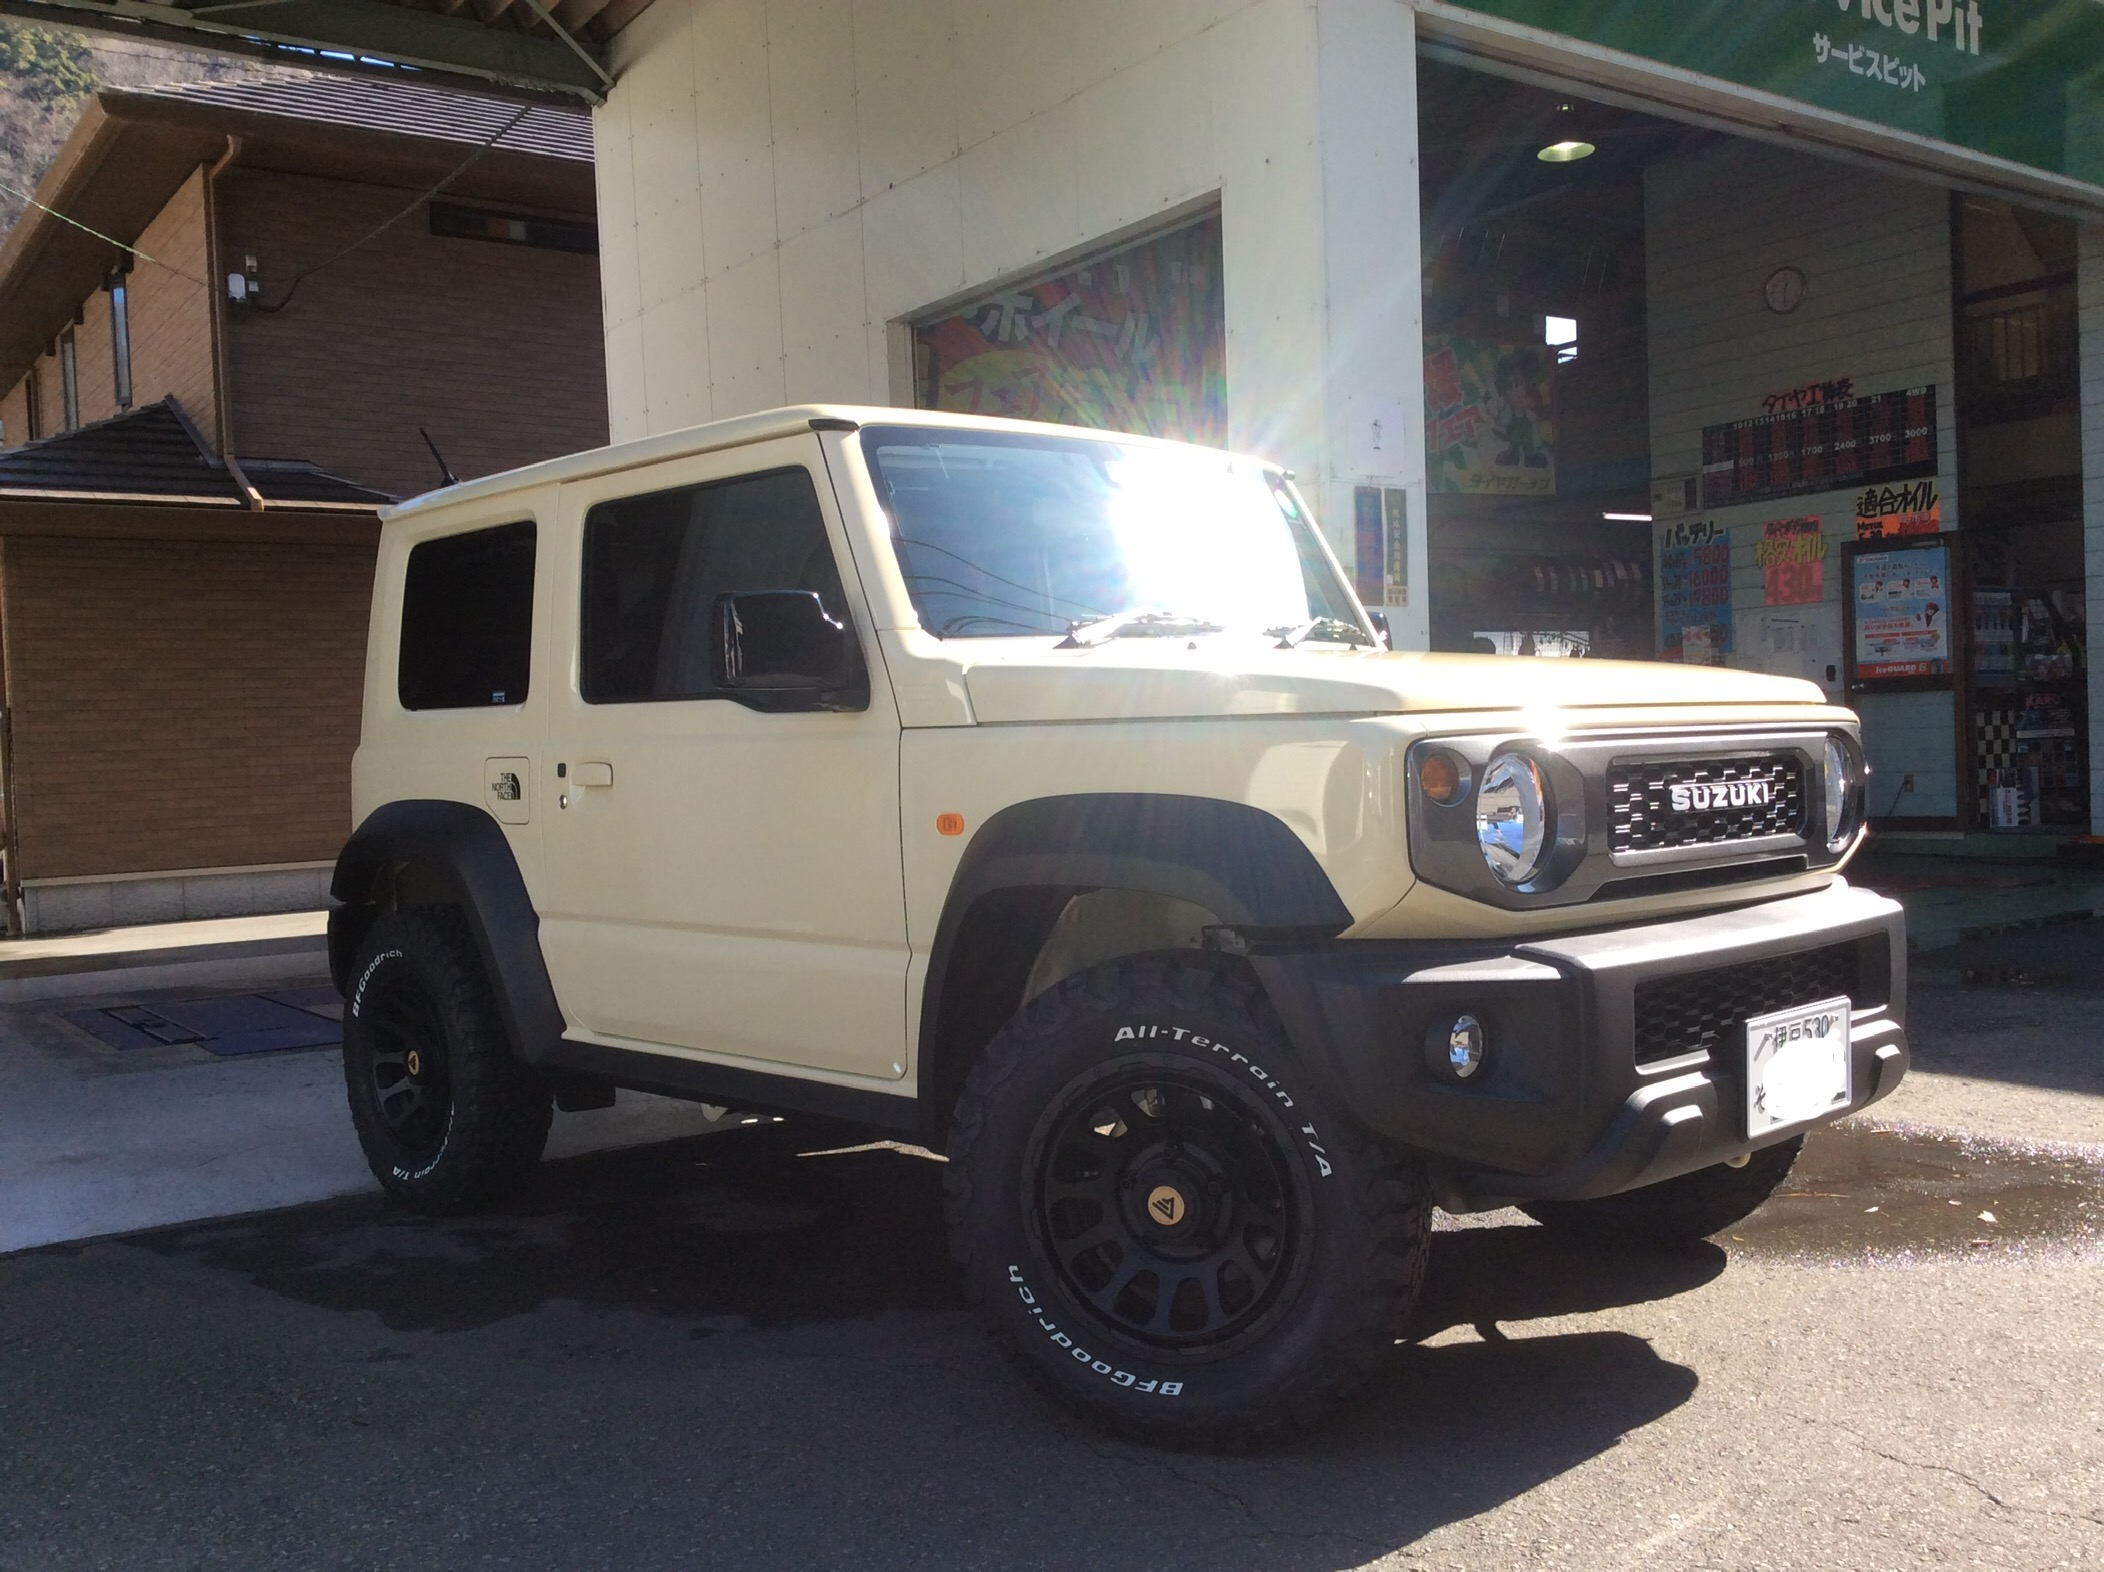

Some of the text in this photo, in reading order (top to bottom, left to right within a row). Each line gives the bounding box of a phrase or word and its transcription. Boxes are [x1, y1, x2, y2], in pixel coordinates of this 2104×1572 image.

[1837, 0, 1983, 56] ce Pit
[1813, 32, 1926, 93] サービスピット
[1802, 406, 1812, 418] 17
[1846, 399, 1858, 410] 20
[1801, 444, 1824, 456] 1700
[1834, 440, 1856, 451] 2400
[1868, 433, 1892, 445] 3700
[1904, 426, 1928, 438] 3000
[1856, 481, 1940, 518] 適合オイル
[1665, 520, 1724, 548] バッテリー
[1756, 534, 1829, 568] 格安オイル
[1876, 664, 1917, 674] iceGUARD
[492, 782, 512, 792] NORTH
[500, 772, 510, 782] THE
[497, 792, 512, 800] FACE
[1671, 782, 1770, 812] SUZUKI
[352, 948, 403, 1018] BFGoodrich
[1114, 1025, 1333, 1178] All-Terrain T/A
[392, 1165, 410, 1181] T/A
[1008, 1264, 1184, 1396] BFGoodrich
